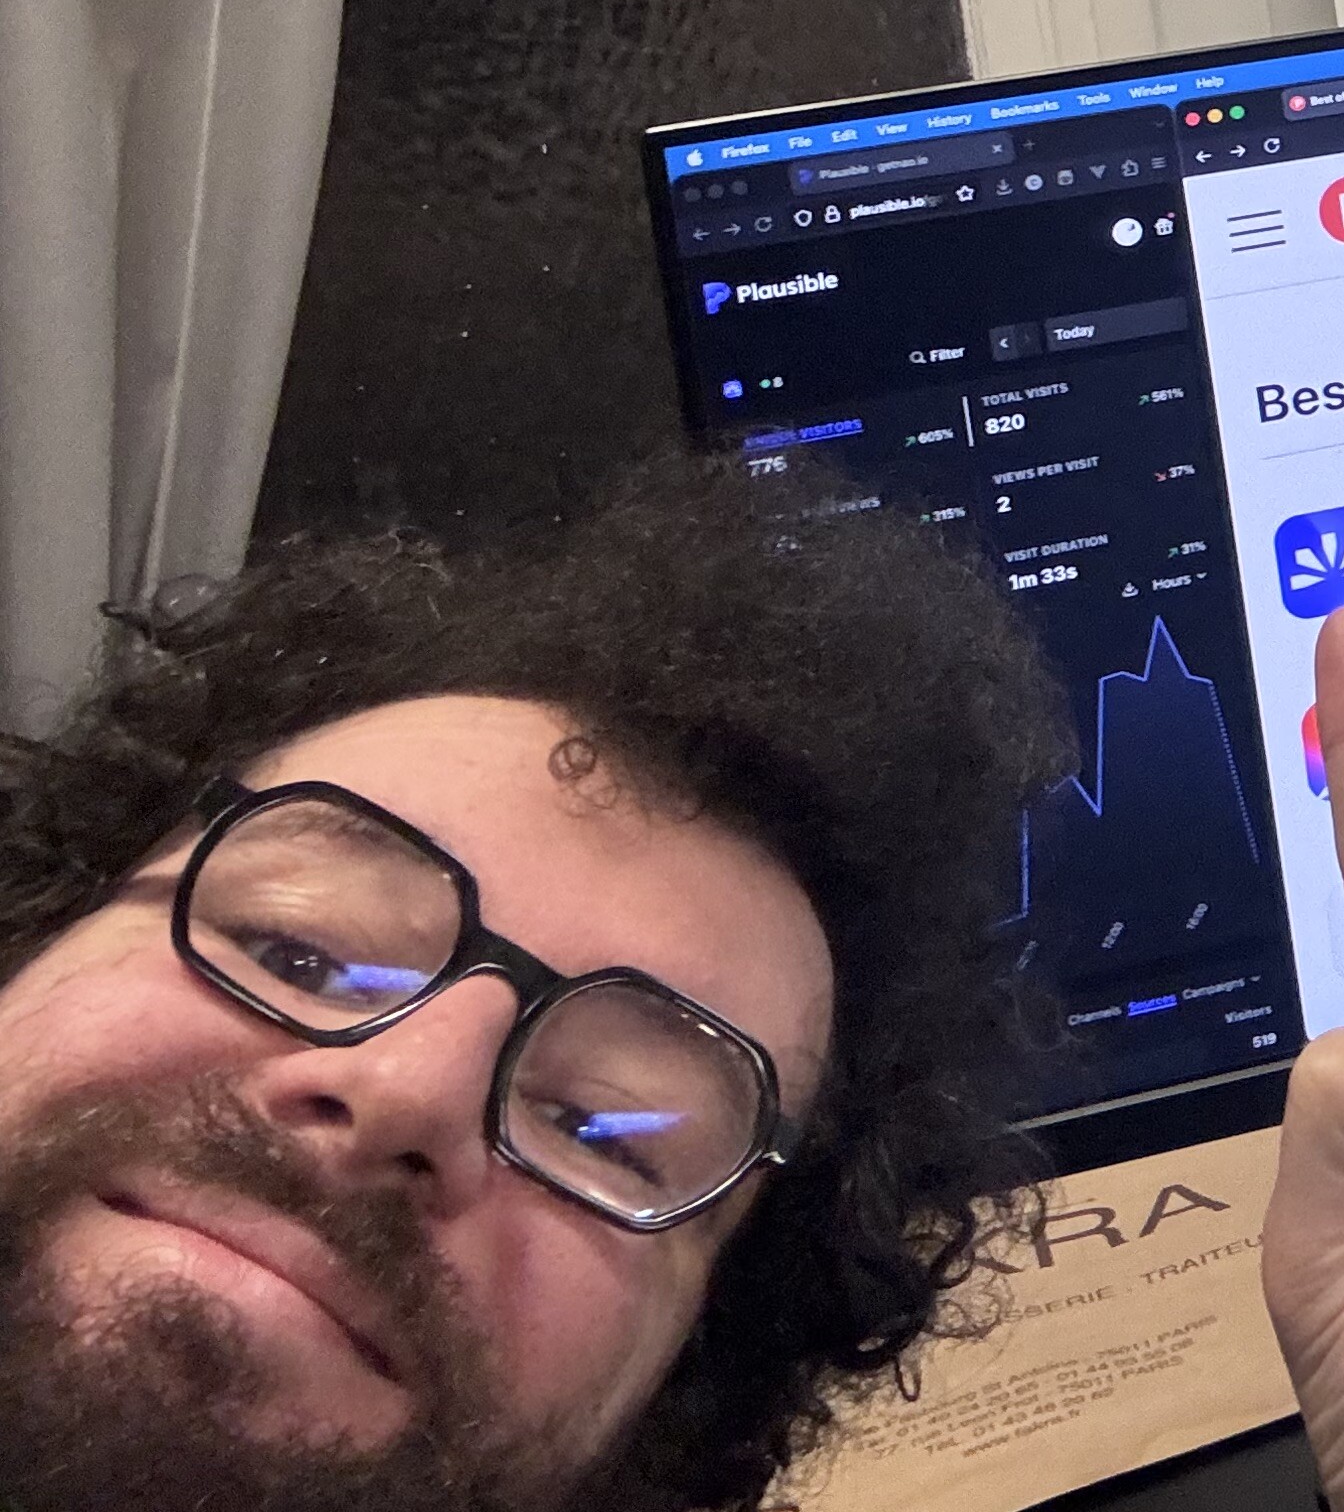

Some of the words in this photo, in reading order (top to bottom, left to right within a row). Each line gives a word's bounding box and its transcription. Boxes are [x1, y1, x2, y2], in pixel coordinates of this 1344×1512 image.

[1309, 93, 1335, 107] Best
[721, 142, 770, 159] Firefox
[788, 136, 813, 150] File
[831, 127, 859, 143] Edit
[874, 121, 908, 137] View
[926, 111, 972, 129] History
[990, 99, 1060, 120] Bookmarks
[1077, 92, 1111, 106] Tools
[1128, 82, 1178, 99] Window
[1195, 75, 1225, 90] Help
[736, 271, 840, 304] Plausible
[1053, 324, 1096, 344] Today
[929, 344, 966, 363] Filter
[981, 389, 1023, 407] TOTAL
[1024, 382, 1070, 400] VISITS
[800, 419, 863, 439] VISITORS
[984, 413, 1026, 435] 820
[917, 428, 953, 444] 605%
[992, 469, 1036, 485] VIEWS
[1037, 464, 1064, 479] PER
[1065, 456, 1100, 473] VISIT
[1168, 464, 1196, 479] 37%
[995, 496, 1012, 514] 2
[1003, 547, 1039, 563] VISIT
[1041, 534, 1109, 556] DURATION
[1181, 541, 1208, 555] 31%
[1008, 572, 1038, 591] 1m
[1040, 565, 1079, 585] 33s
[1152, 574, 1192, 591] Hours
[1067, 1005, 1122, 1027] Channels
[1225, 1004, 1273, 1024] Visitors
[1252, 1032, 1278, 1049] 519
[992, 1284, 1118, 1325] SSERIE
